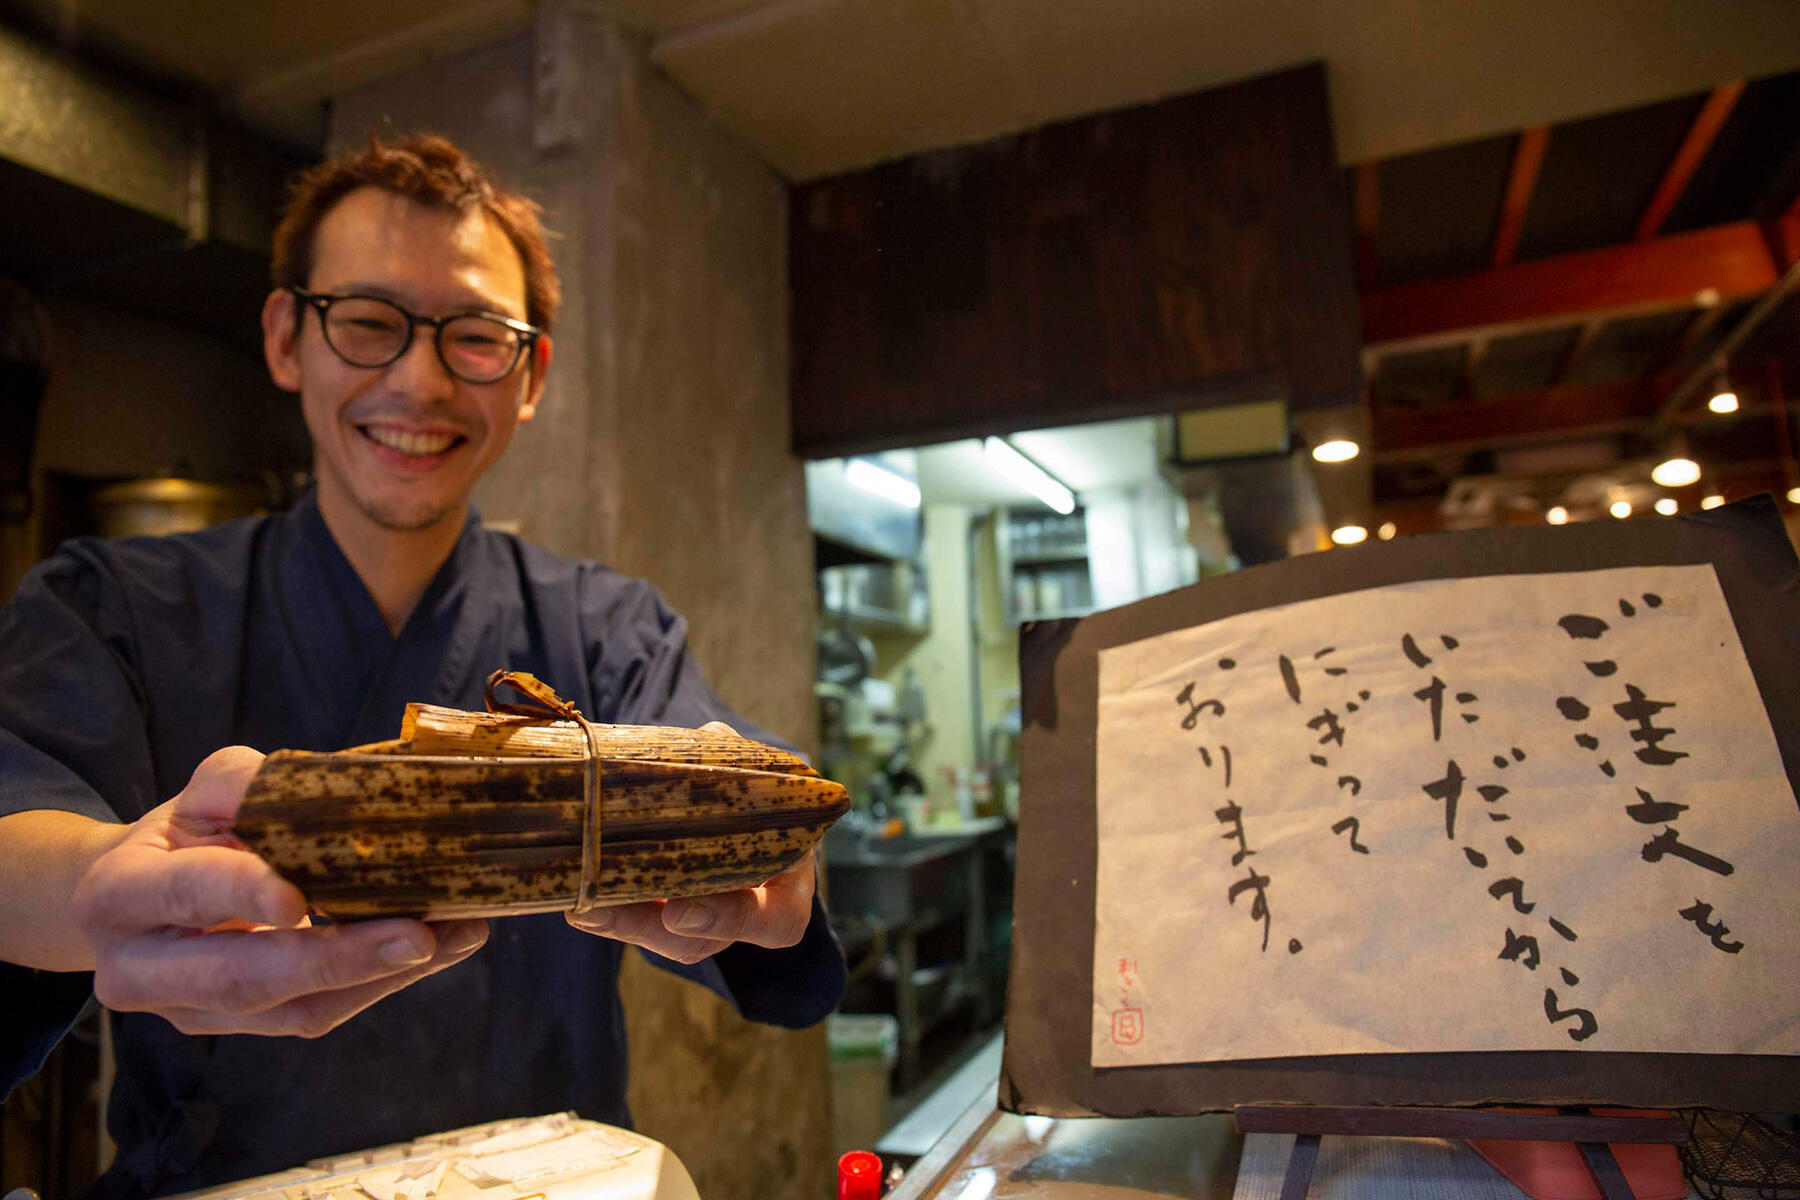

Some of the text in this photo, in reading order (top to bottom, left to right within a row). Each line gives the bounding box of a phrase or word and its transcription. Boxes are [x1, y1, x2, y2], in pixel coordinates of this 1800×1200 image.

[1177, 658, 1304, 952] おります。
[1279, 647, 1371, 855] にぎって
[1402, 633, 1600, 1043] いただいてから
[1555, 592, 1746, 956] ご注文を
